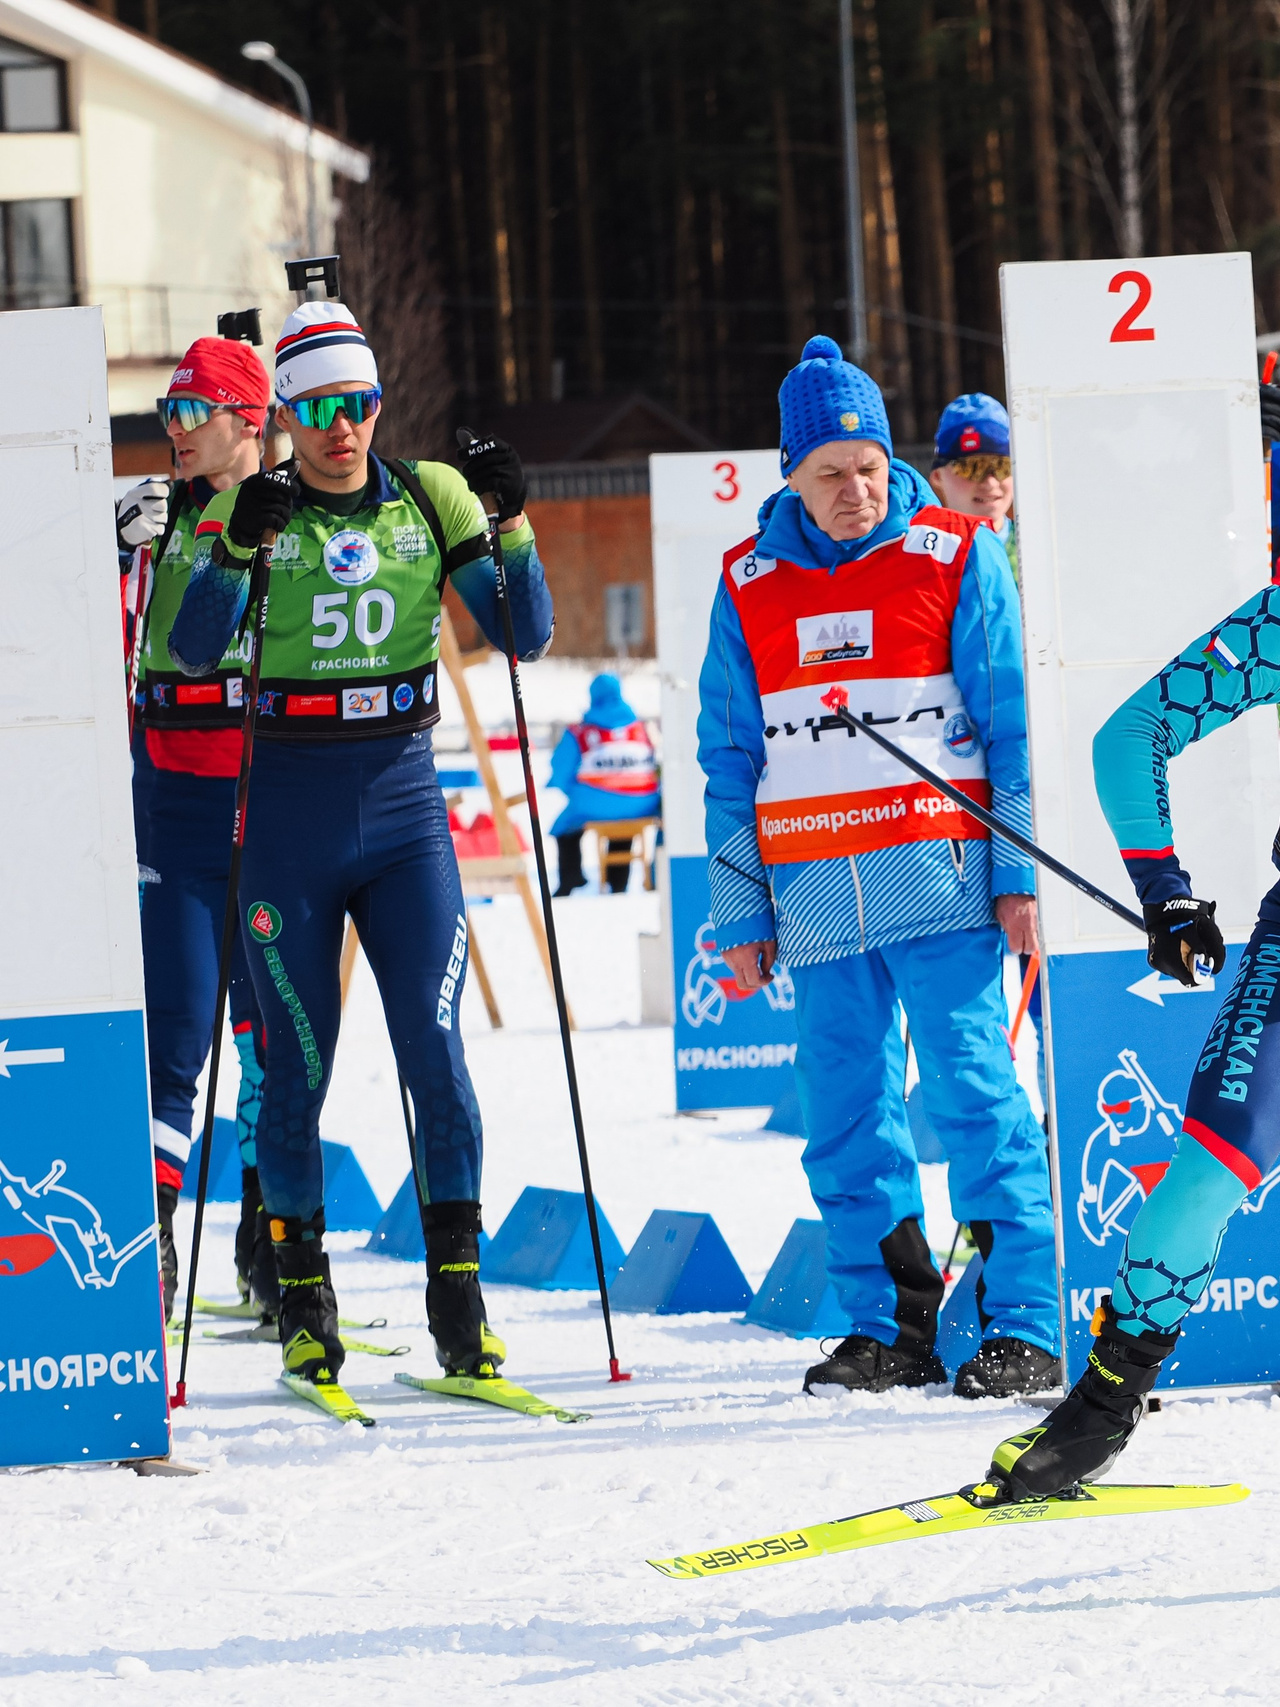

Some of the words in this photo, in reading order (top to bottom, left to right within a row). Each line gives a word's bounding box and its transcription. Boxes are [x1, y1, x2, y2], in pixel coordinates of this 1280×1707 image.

[1107, 269, 1156, 344] 2
[468, 440, 497, 457] MOAX
[264, 471, 292, 488] MOAX
[712, 461, 741, 503] 3
[922, 530, 938, 552] 8
[493, 565, 505, 600] MOAX
[743, 554, 758, 578] 8
[259, 595, 269, 630] MOAX
[311, 587, 397, 650] 50
[311, 654, 391, 672] КРАСНОЯРСК
[761, 797, 907, 841] Красноярский
[914, 790, 967, 818] кра
[263, 945, 323, 1091] БЕЛОРУСНЕФТЬ
[676, 1043, 798, 1072] КРАСНОЯР
[982, 1503, 1051, 1524] FISCHER
[700, 1533, 809, 1570] FISCHER
